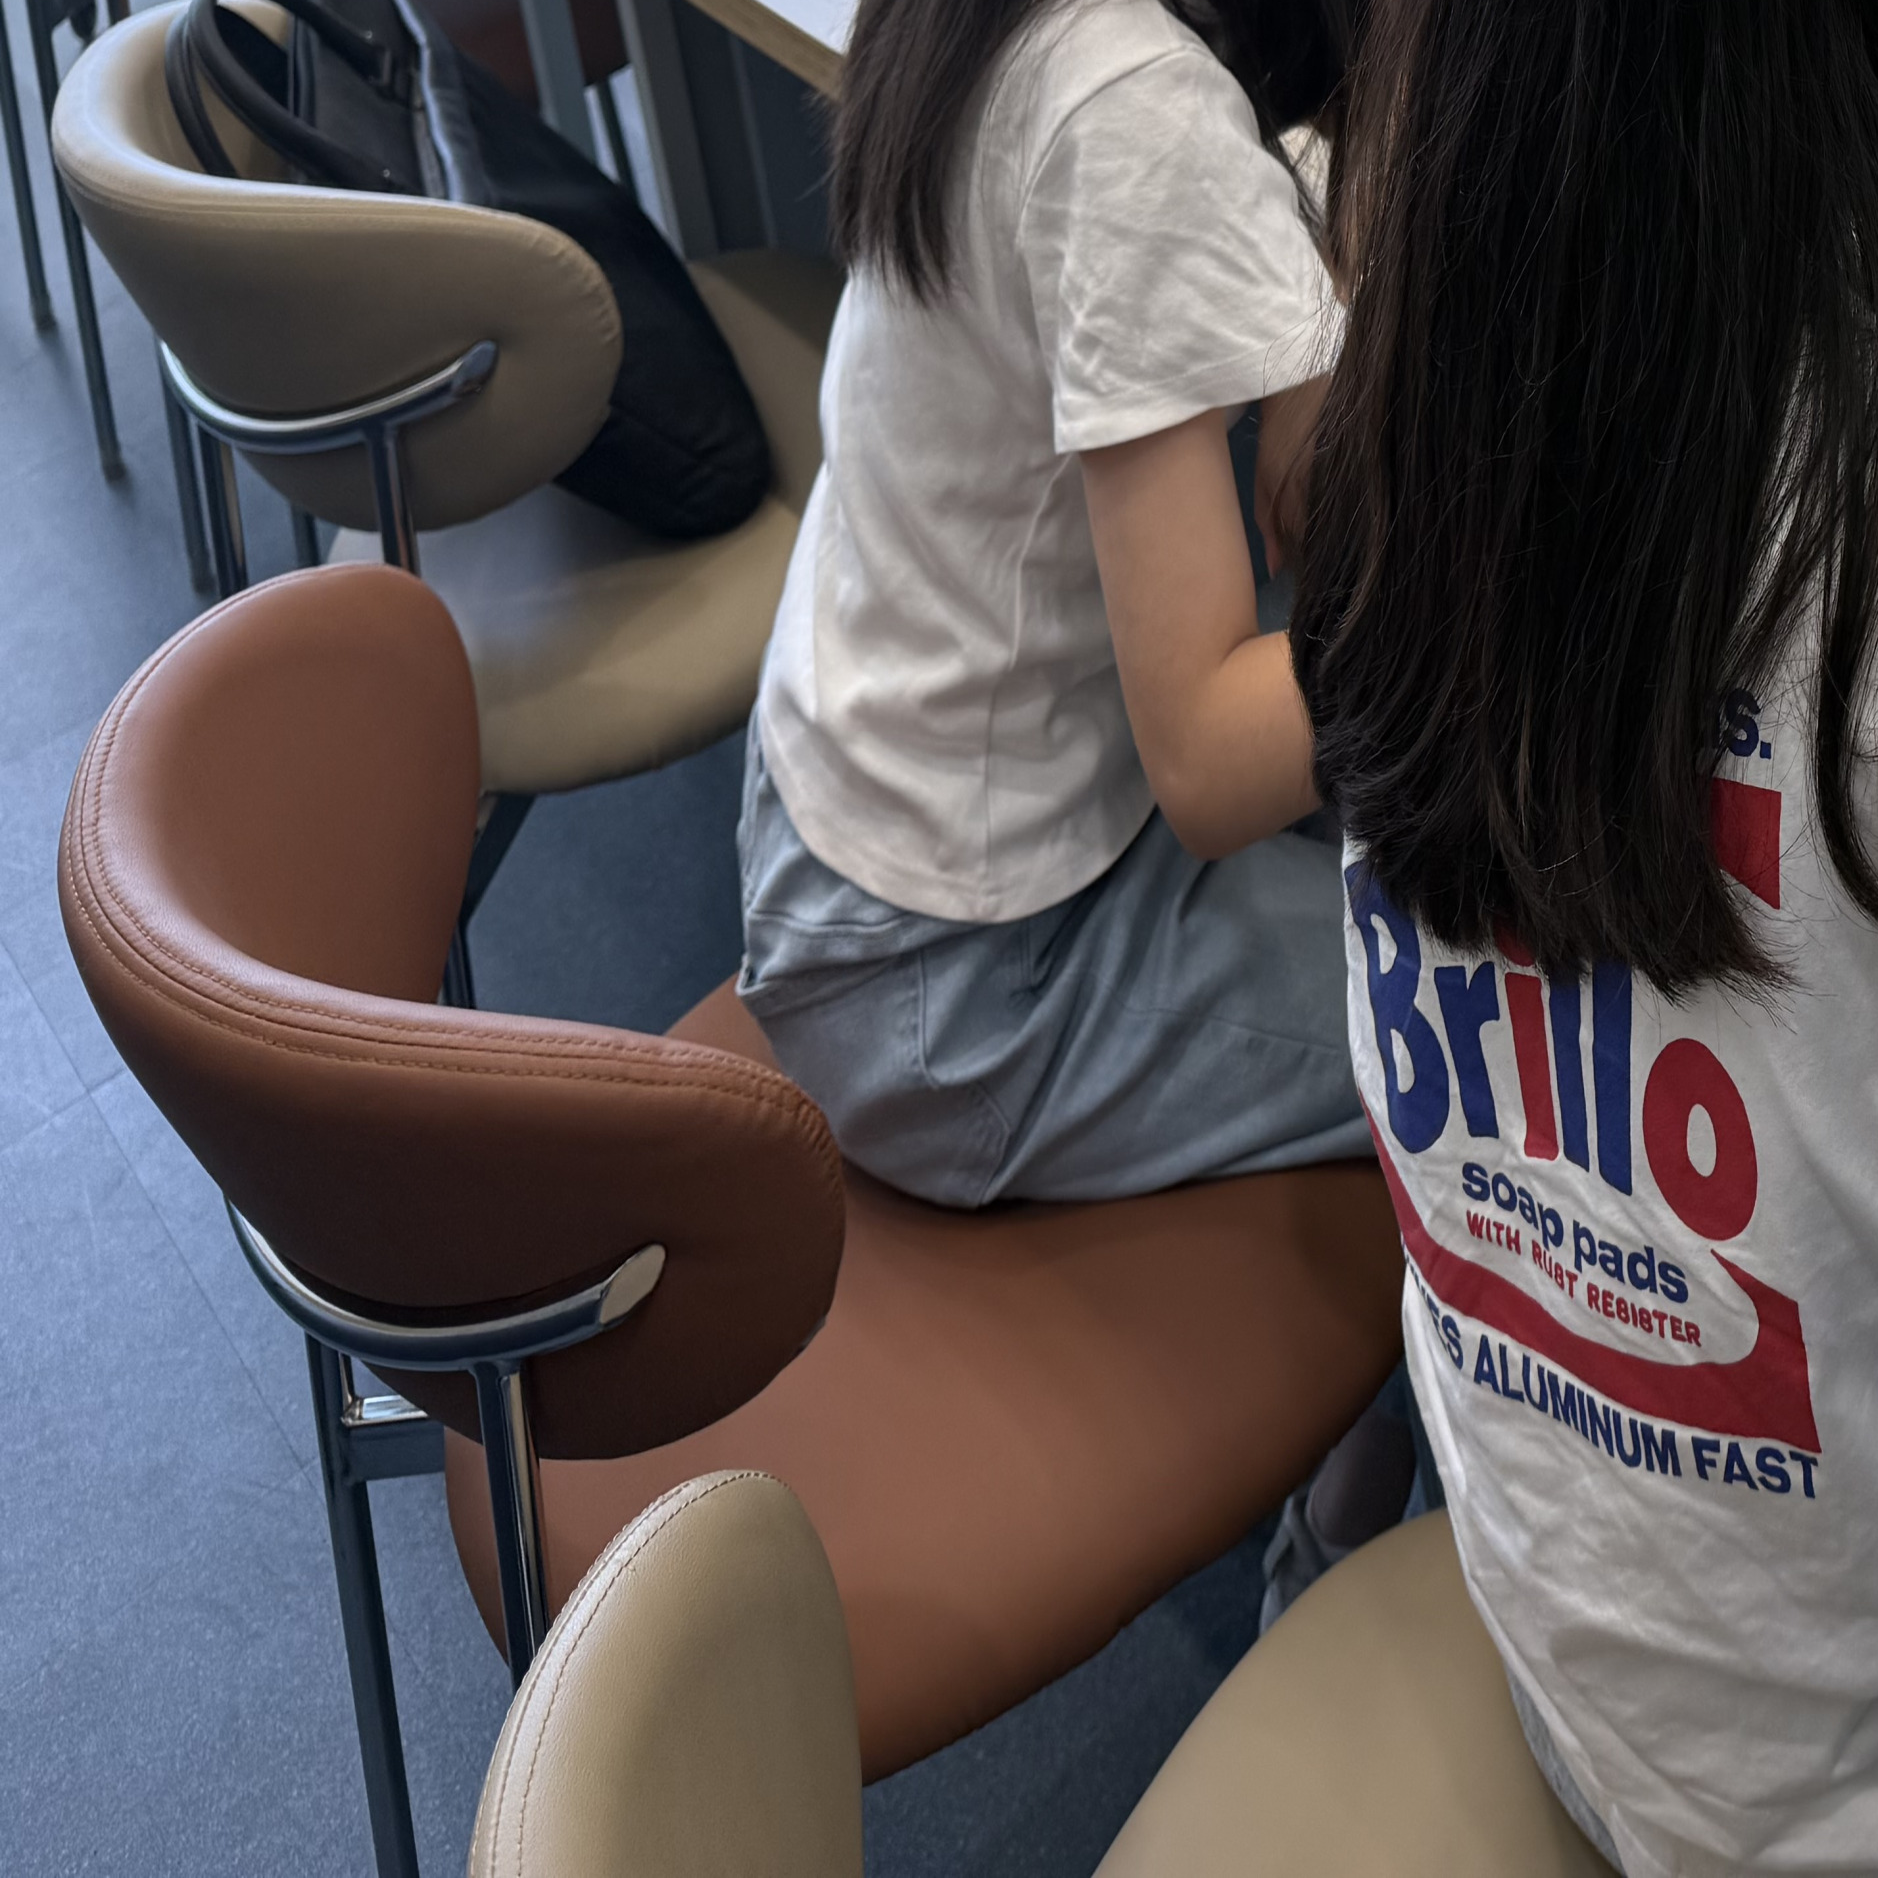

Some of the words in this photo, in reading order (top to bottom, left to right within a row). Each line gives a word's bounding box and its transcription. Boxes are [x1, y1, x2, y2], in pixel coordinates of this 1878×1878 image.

[1344, 860, 1758, 1241] Brillo
[1462, 1161, 1564, 1252] soap
[1573, 1219, 1689, 1304] pads
[1466, 1209, 1521, 1256] WITH
[1532, 1239, 1578, 1299] RUST
[1473, 1334, 1682, 1477] ALUMINUM
[1691, 1435, 1819, 1500] FAST
